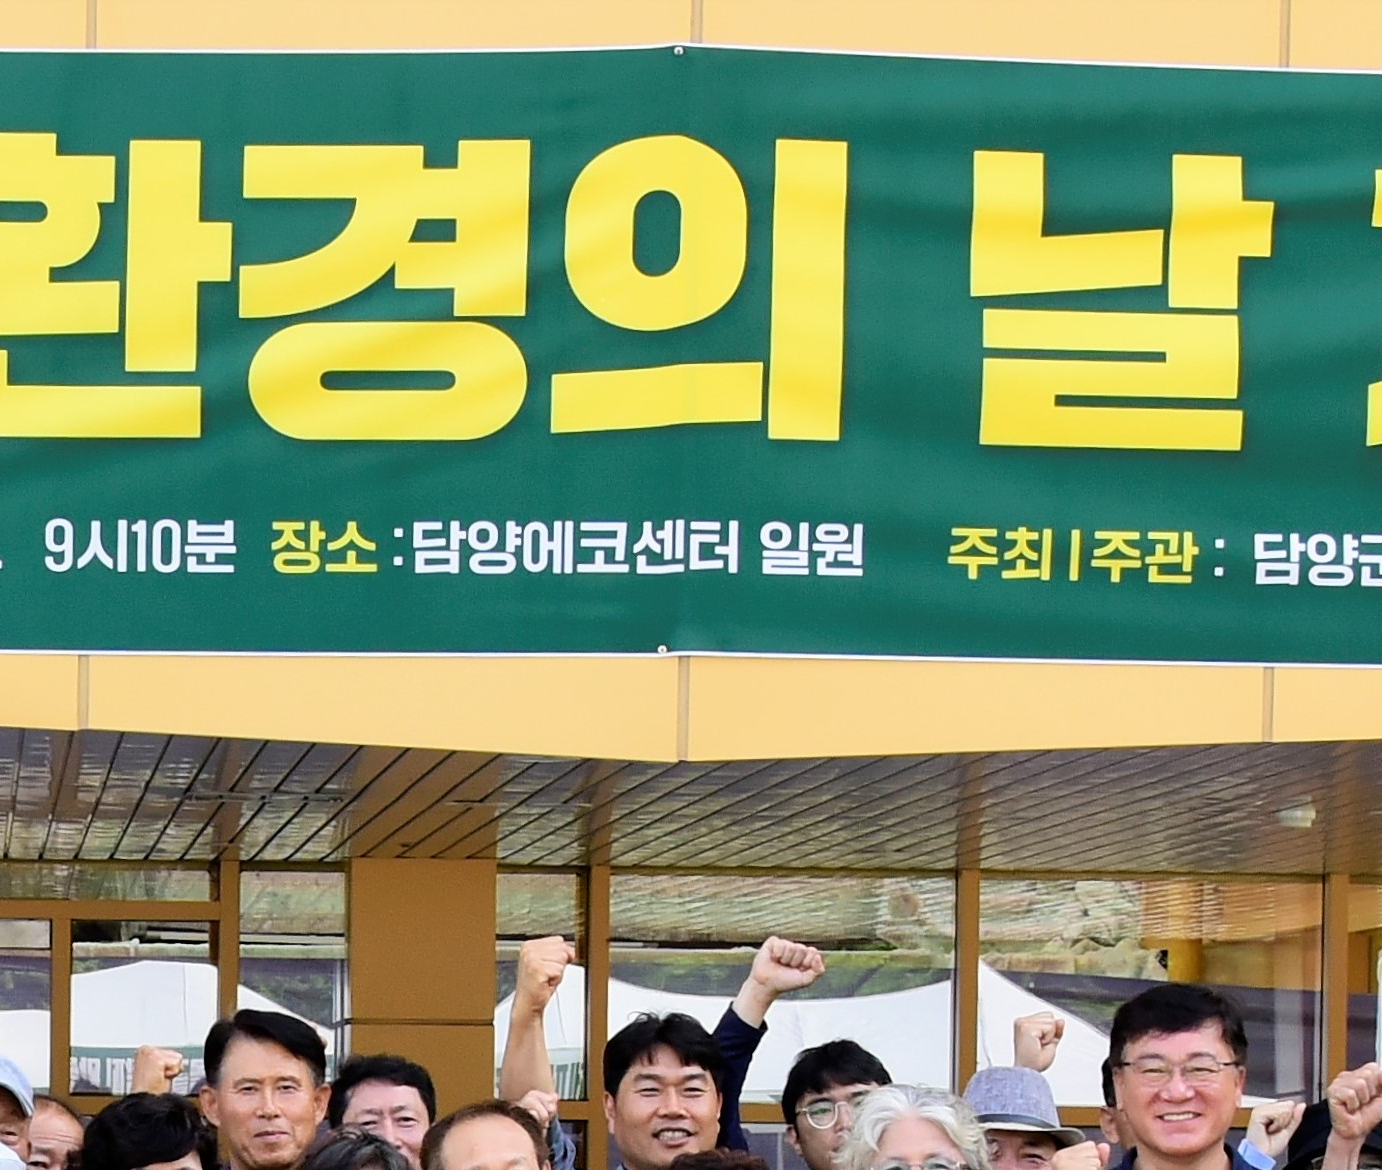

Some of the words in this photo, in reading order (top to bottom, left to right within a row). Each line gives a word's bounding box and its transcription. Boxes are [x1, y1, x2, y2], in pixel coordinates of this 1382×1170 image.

[970, 150, 1275, 451] 날
[44, 518, 237, 573] 9시10분
[271, 520, 378, 574] 장소
[760, 521, 864, 577] 일원
